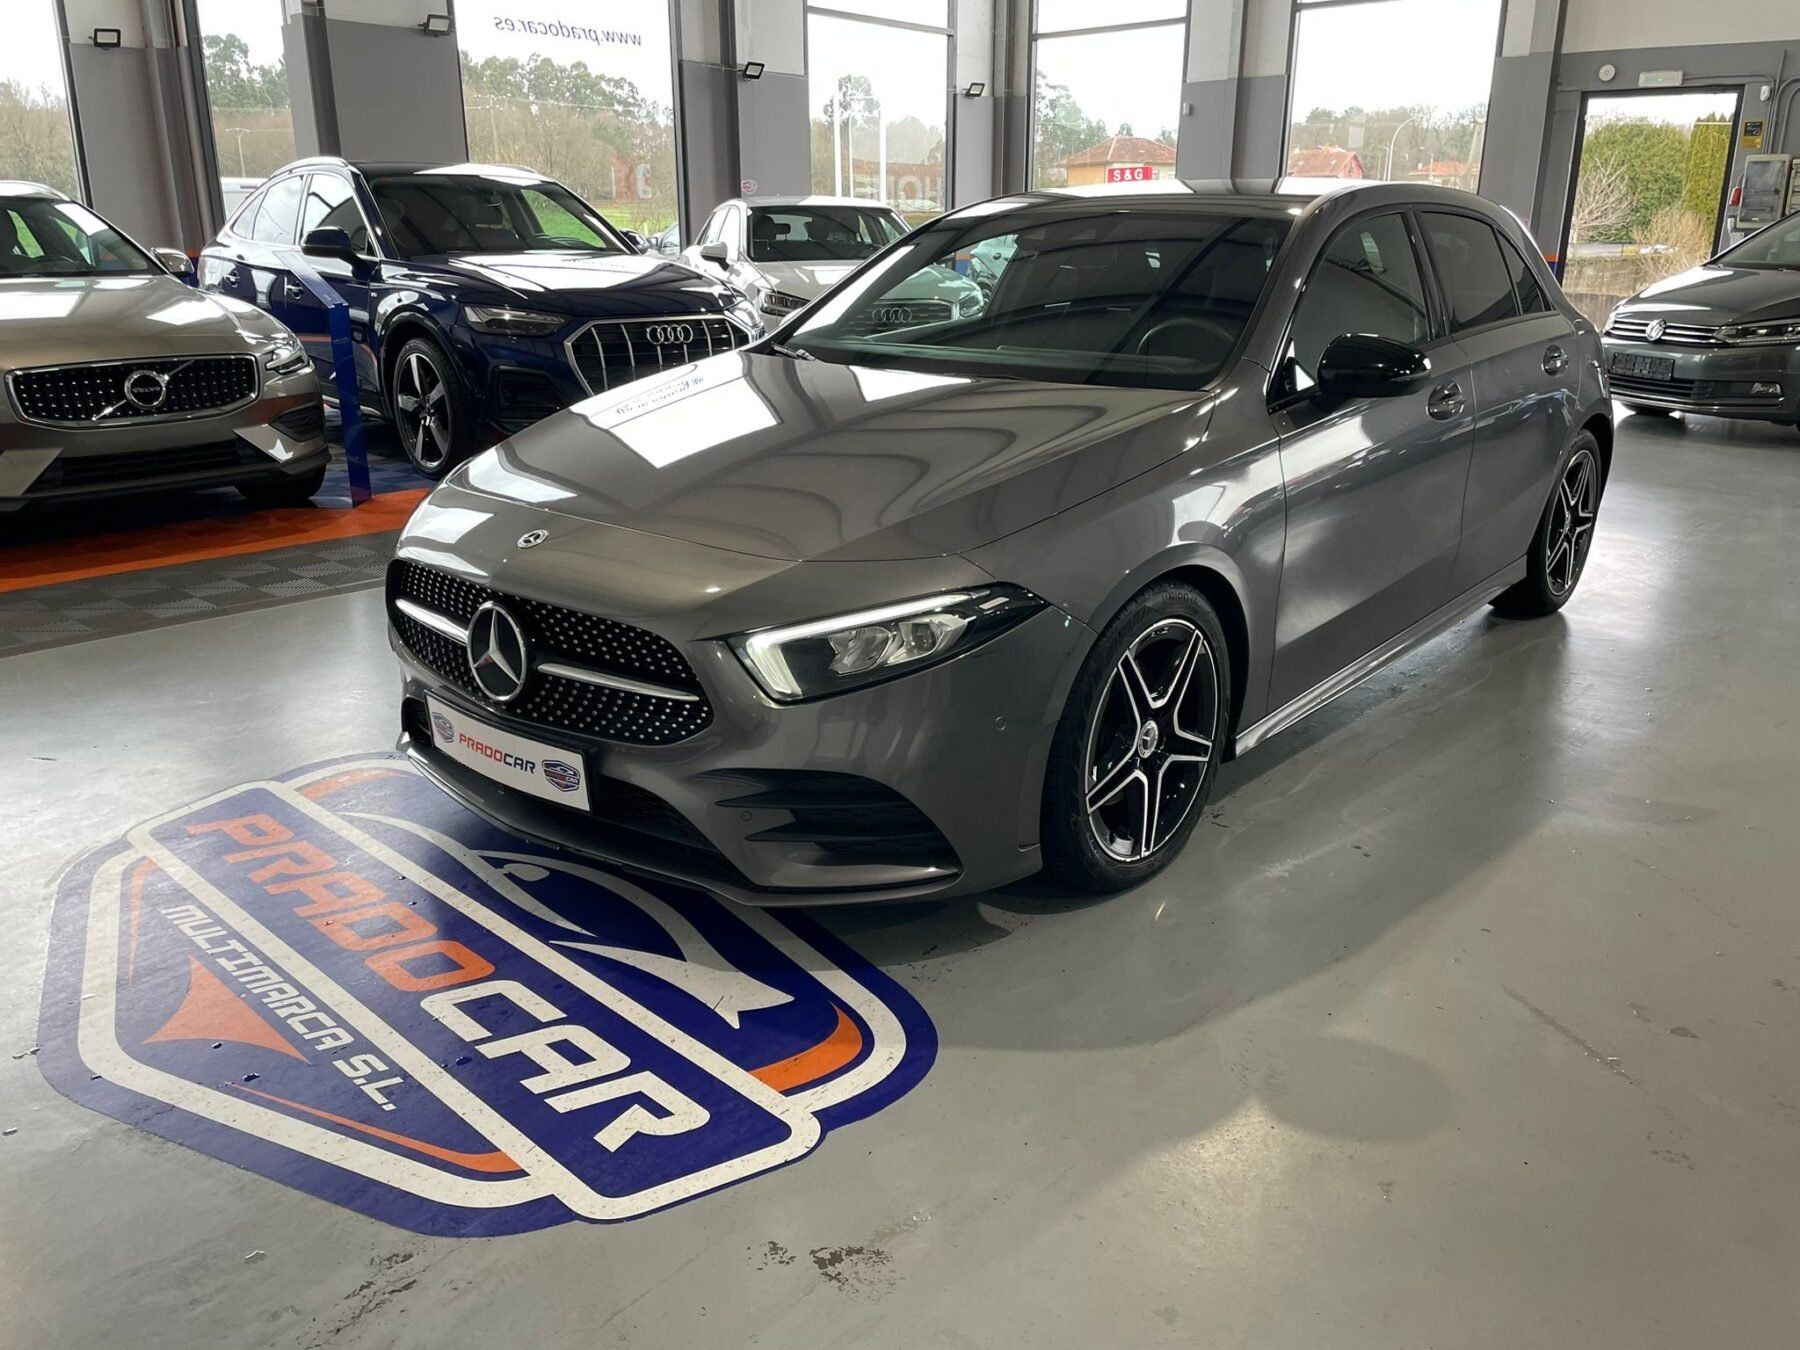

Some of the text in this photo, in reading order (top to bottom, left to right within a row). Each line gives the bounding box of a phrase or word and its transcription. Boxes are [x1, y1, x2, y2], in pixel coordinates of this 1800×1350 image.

[1113, 168, 1143, 181] S & G
[459, 733, 536, 774] PRADOCAR
[161, 904, 405, 1111] MULTIMARCA S.L.
[187, 814, 710, 1152] PRADOCAR
